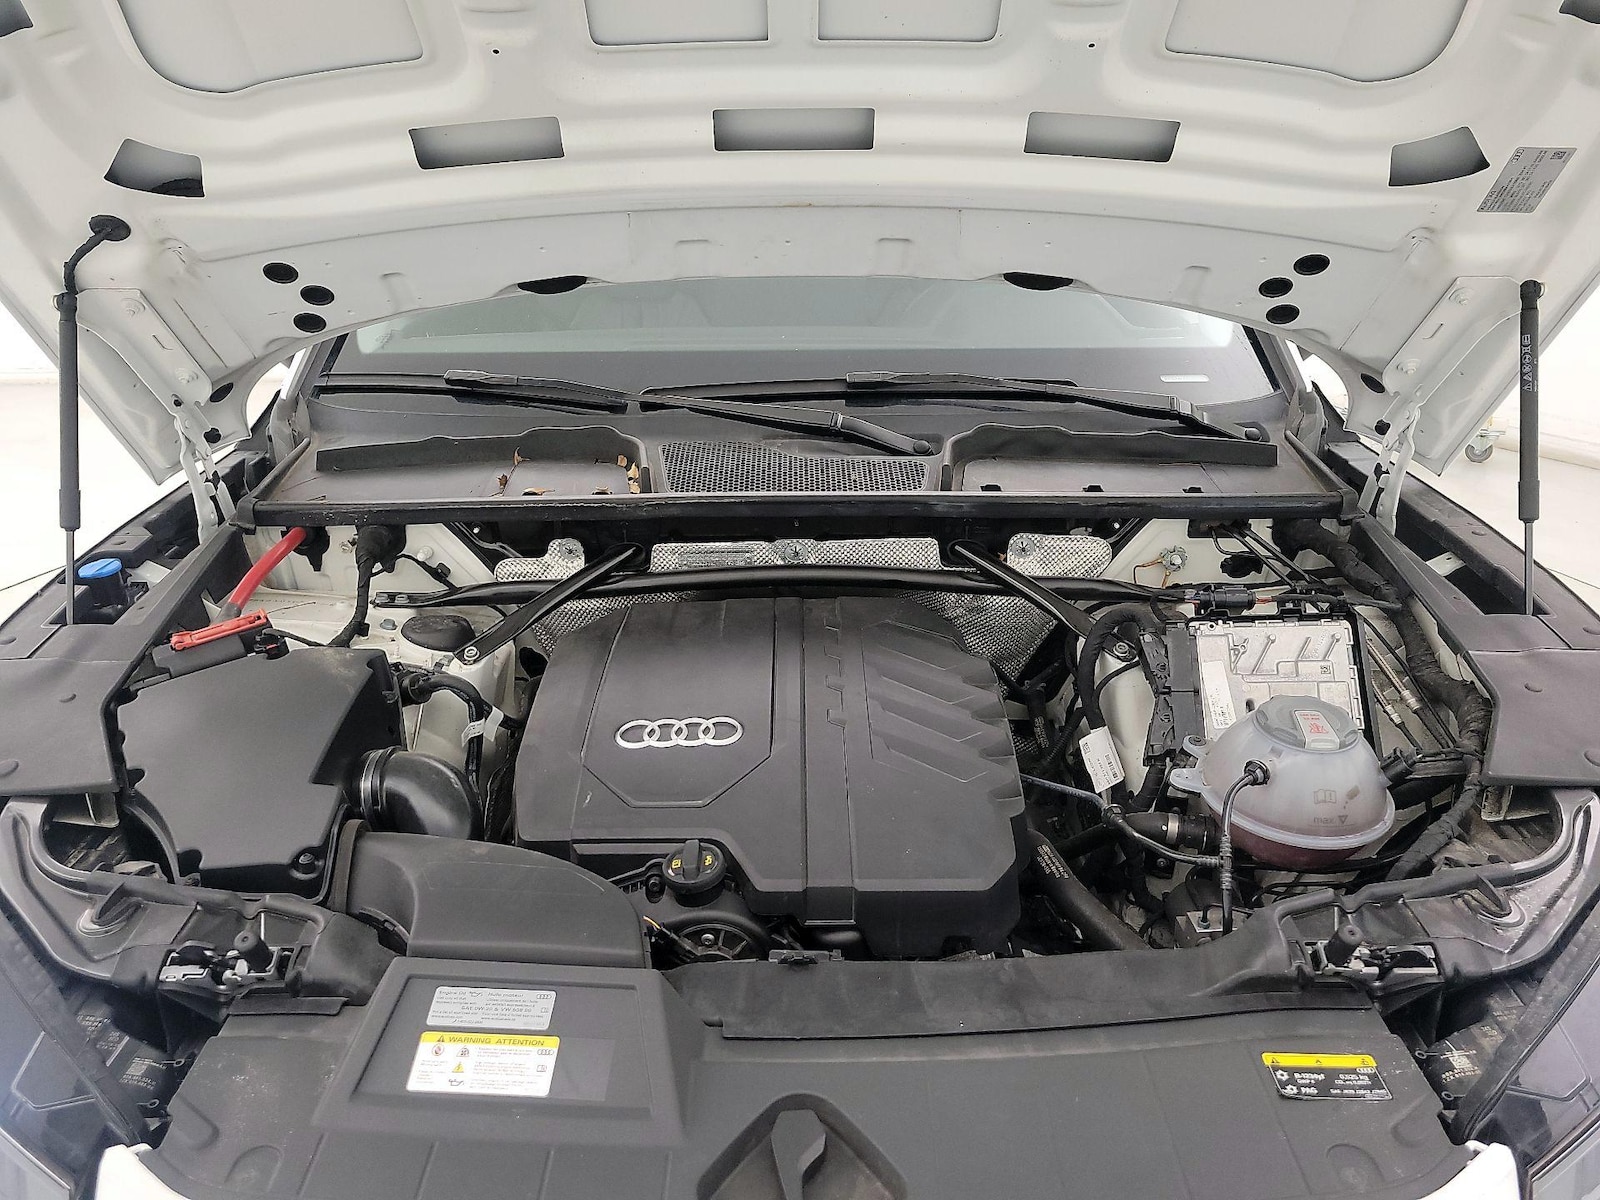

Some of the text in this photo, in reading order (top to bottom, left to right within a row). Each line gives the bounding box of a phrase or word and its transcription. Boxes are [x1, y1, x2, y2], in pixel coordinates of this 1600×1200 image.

[449, 1036, 545, 1046] WARNING ATTENTION
[1300, 1086, 1319, 1094] PAG
